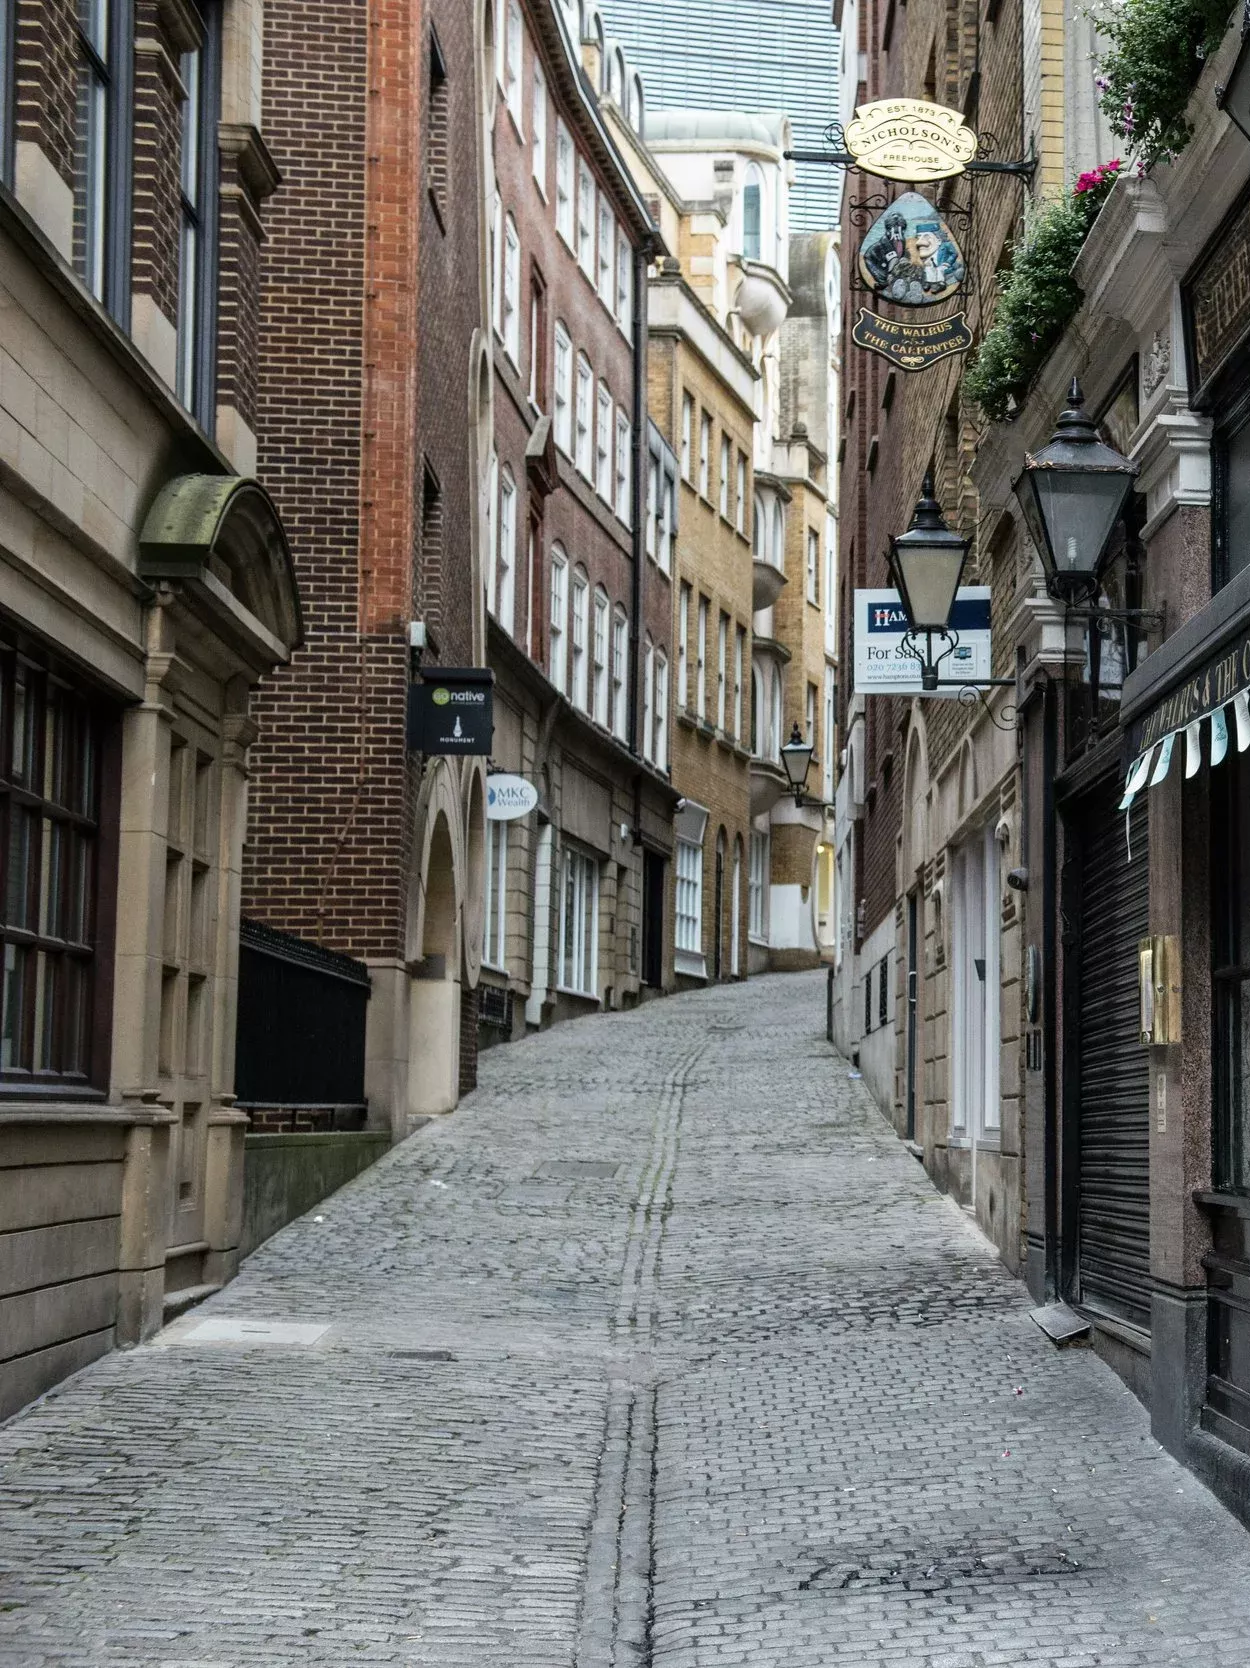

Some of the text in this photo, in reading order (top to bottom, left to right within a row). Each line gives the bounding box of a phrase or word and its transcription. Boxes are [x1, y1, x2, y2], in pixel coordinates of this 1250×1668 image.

[913, 106, 936, 116] 1873
[861, 127, 962, 153] NICHOLSON'S
[883, 154, 940, 163] FREEHOUSE
[873, 319, 952, 336] THE WALRUS
[864, 331, 966, 355] THE CARPENTER
[867, 644, 925, 660] For Sale
[1215, 649, 1239, 702] THE
[450, 690, 485, 701] native
[497, 786, 530, 798] MKC
